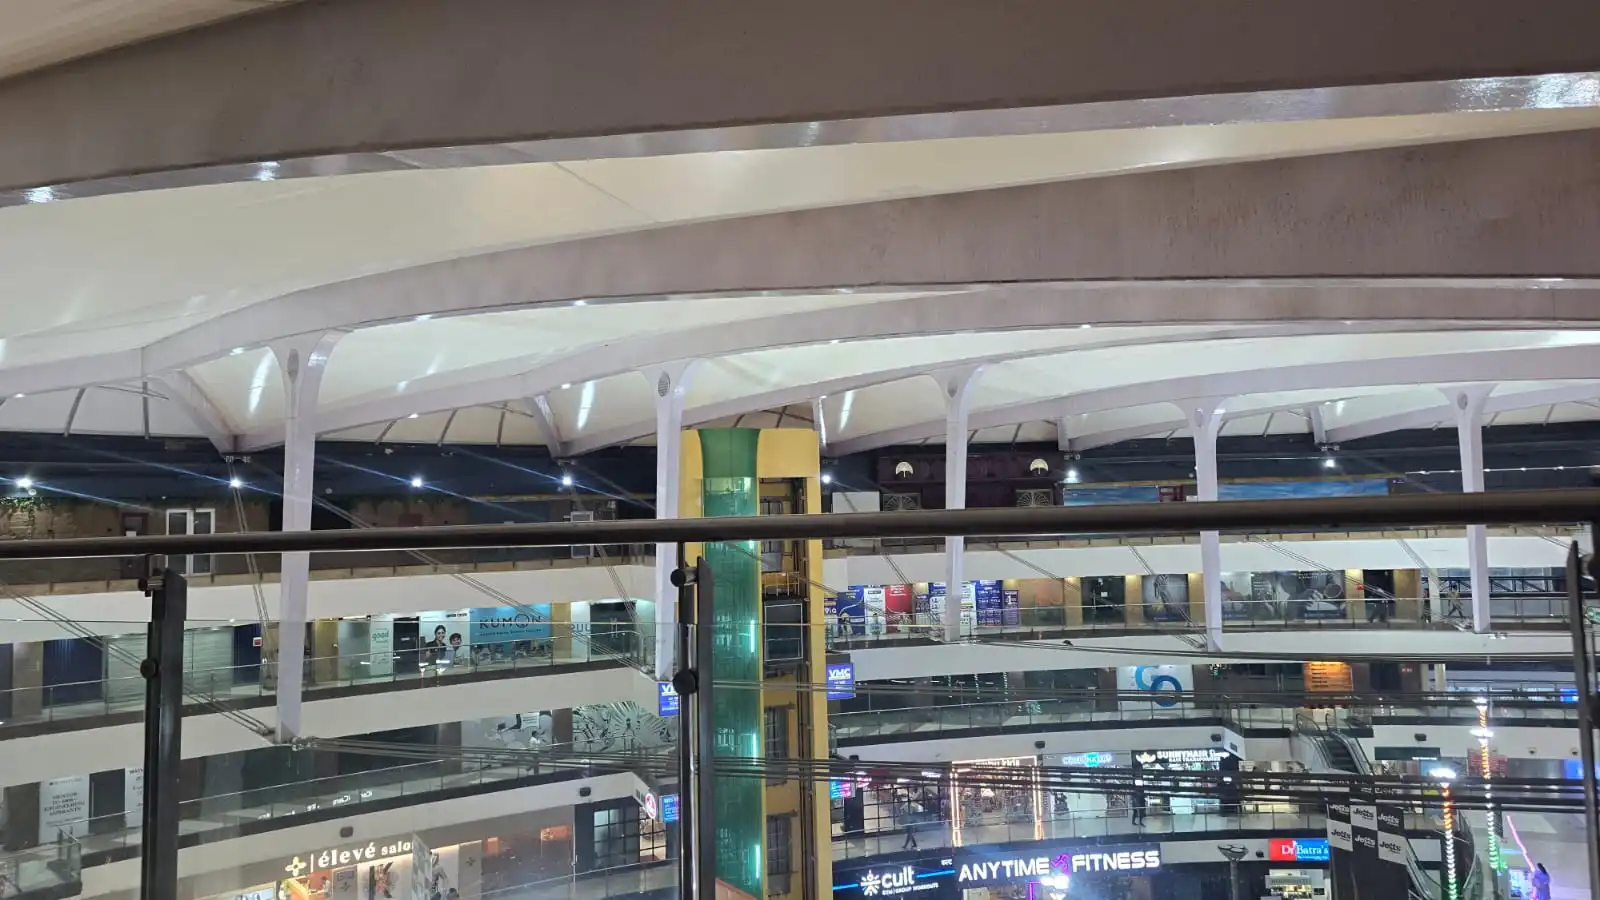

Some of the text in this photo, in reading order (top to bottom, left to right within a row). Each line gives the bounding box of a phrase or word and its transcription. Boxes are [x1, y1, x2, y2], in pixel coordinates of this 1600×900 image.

[479, 613, 541, 629] KUMON
[828, 668, 851, 678] VMC
[1353, 807, 1374, 818] Jetts
[1378, 813, 1400, 824] Jetts
[1331, 829, 1351, 840] Jetts
[1354, 835, 1375, 846] Jetts
[1297, 844, 1329, 855] Batra's
[1380, 841, 1401, 852] Jetts
[318, 841, 414, 868] élevé salo
[958, 851, 1160, 882] ANYTIME FITNESS
[882, 865, 915, 888] cult
